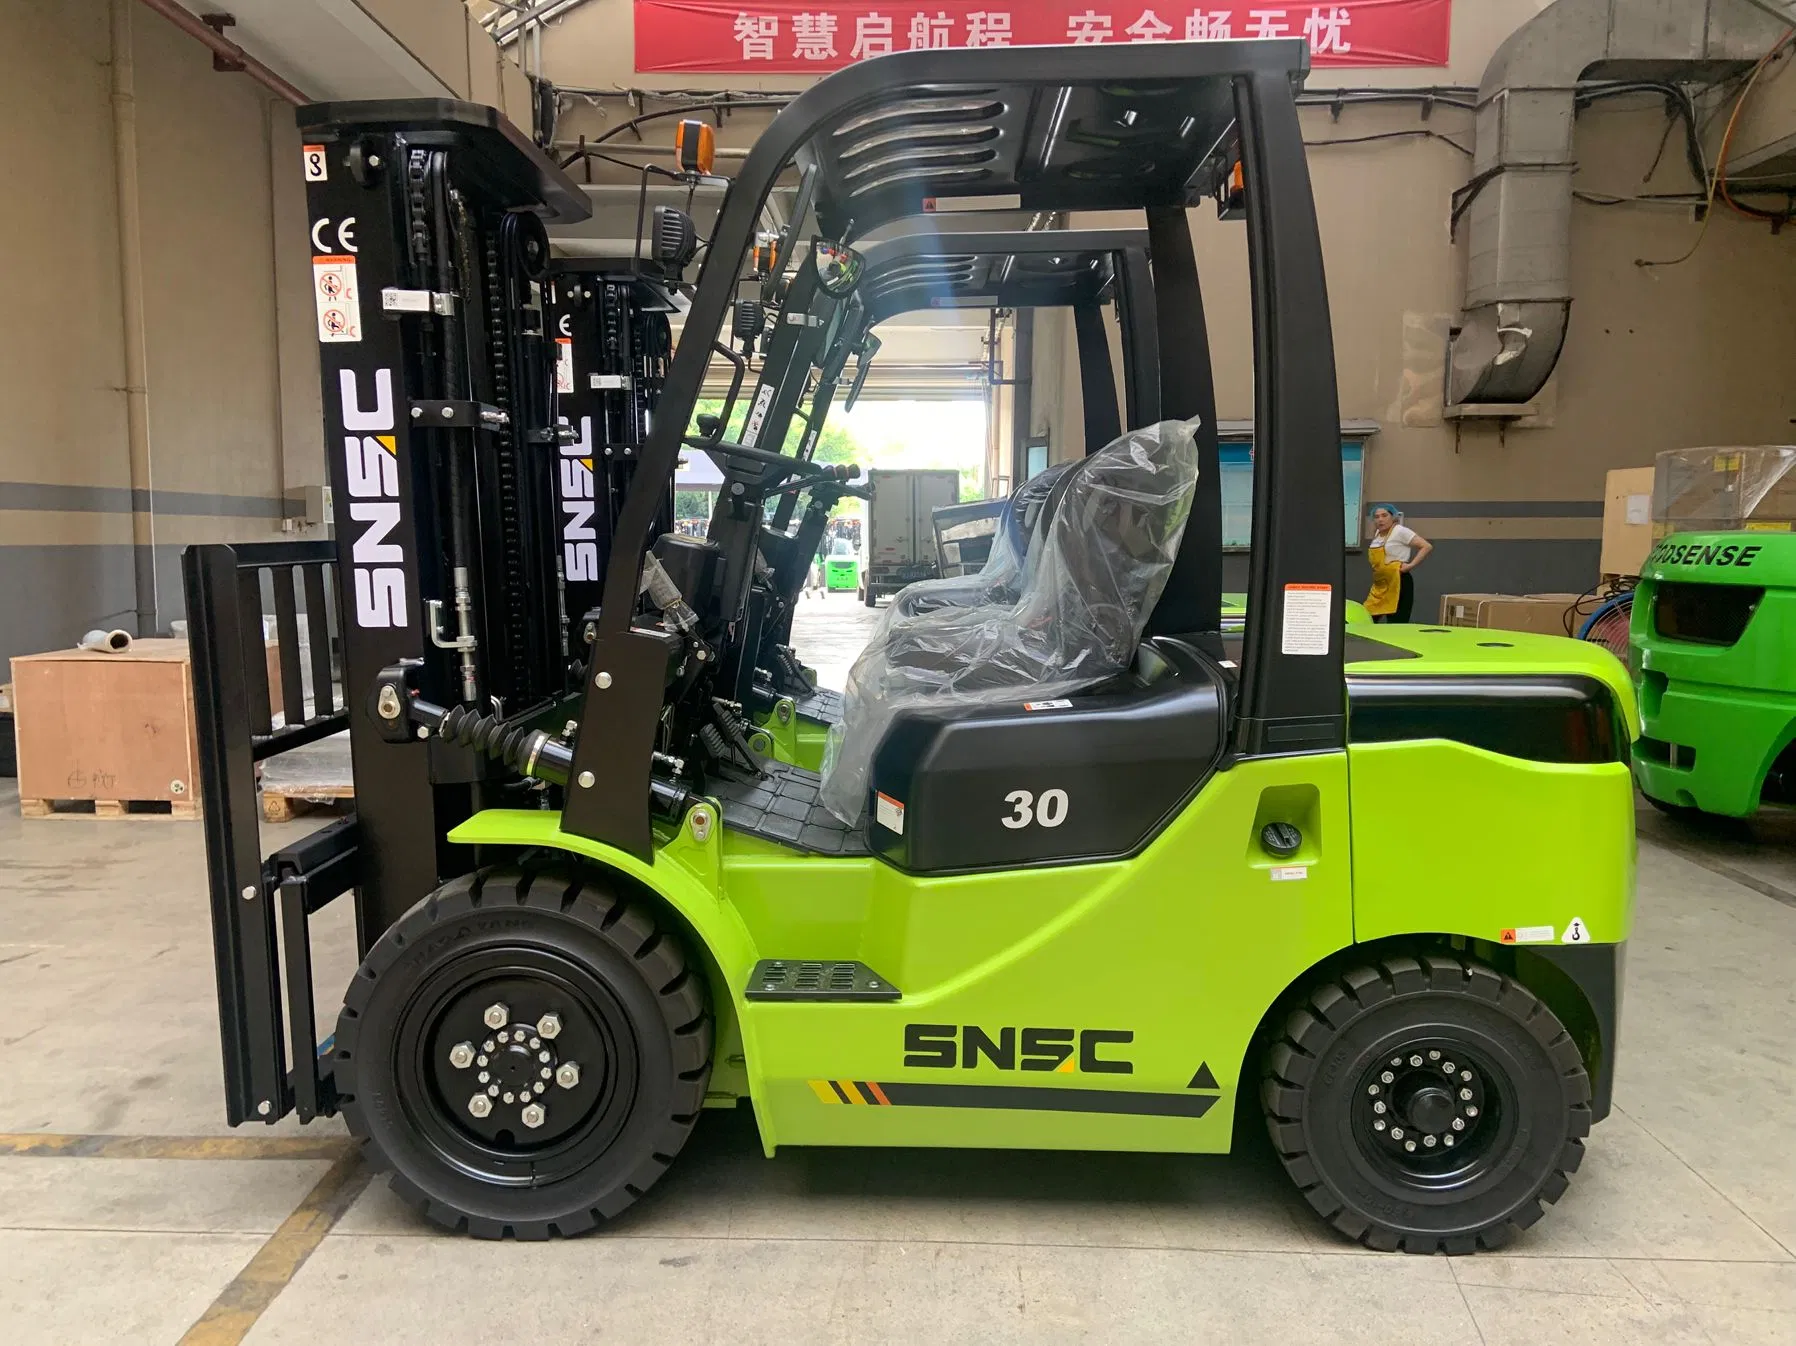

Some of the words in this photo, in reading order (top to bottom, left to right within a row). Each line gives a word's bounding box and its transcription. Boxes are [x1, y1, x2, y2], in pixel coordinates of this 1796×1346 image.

[733, 11, 1013, 60] 智慧启航程
[311, 216, 359, 254] CE
[339, 368, 408, 628] SNSC
[557, 415, 599, 582] SNSC
[1000, 788, 1069, 830] 30
[903, 1023, 1134, 1075] SNSC
